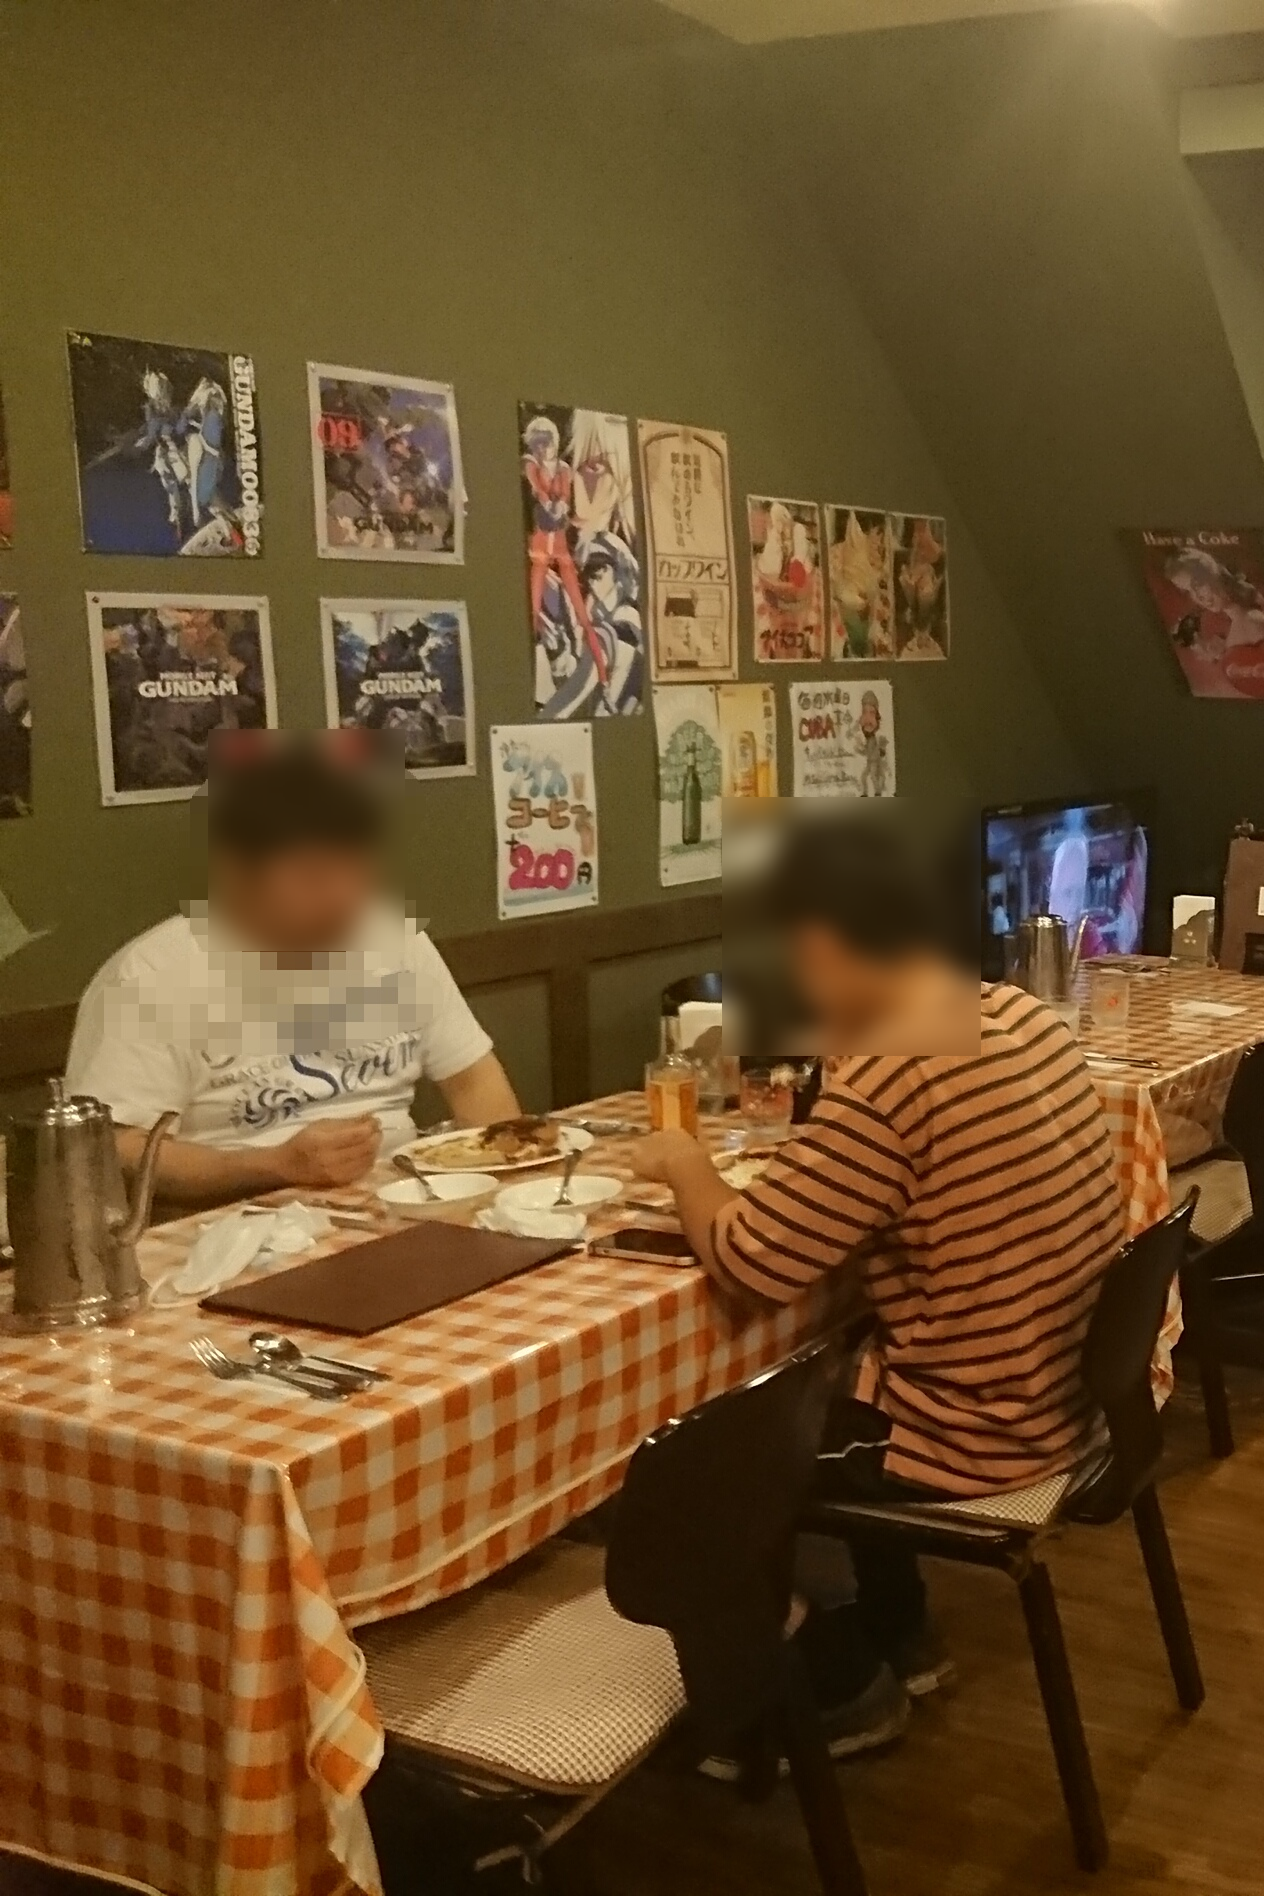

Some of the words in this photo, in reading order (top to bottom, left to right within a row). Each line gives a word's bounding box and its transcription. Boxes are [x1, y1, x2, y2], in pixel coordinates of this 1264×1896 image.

[1143, 532, 1182, 545] Have
[1186, 537, 1196, 545] a
[1198, 531, 1240, 545] Coke
[659, 559, 728, 580] カップワイン
[139, 680, 239, 698] GUNDAM
[360, 678, 443, 695] GUNDAM
